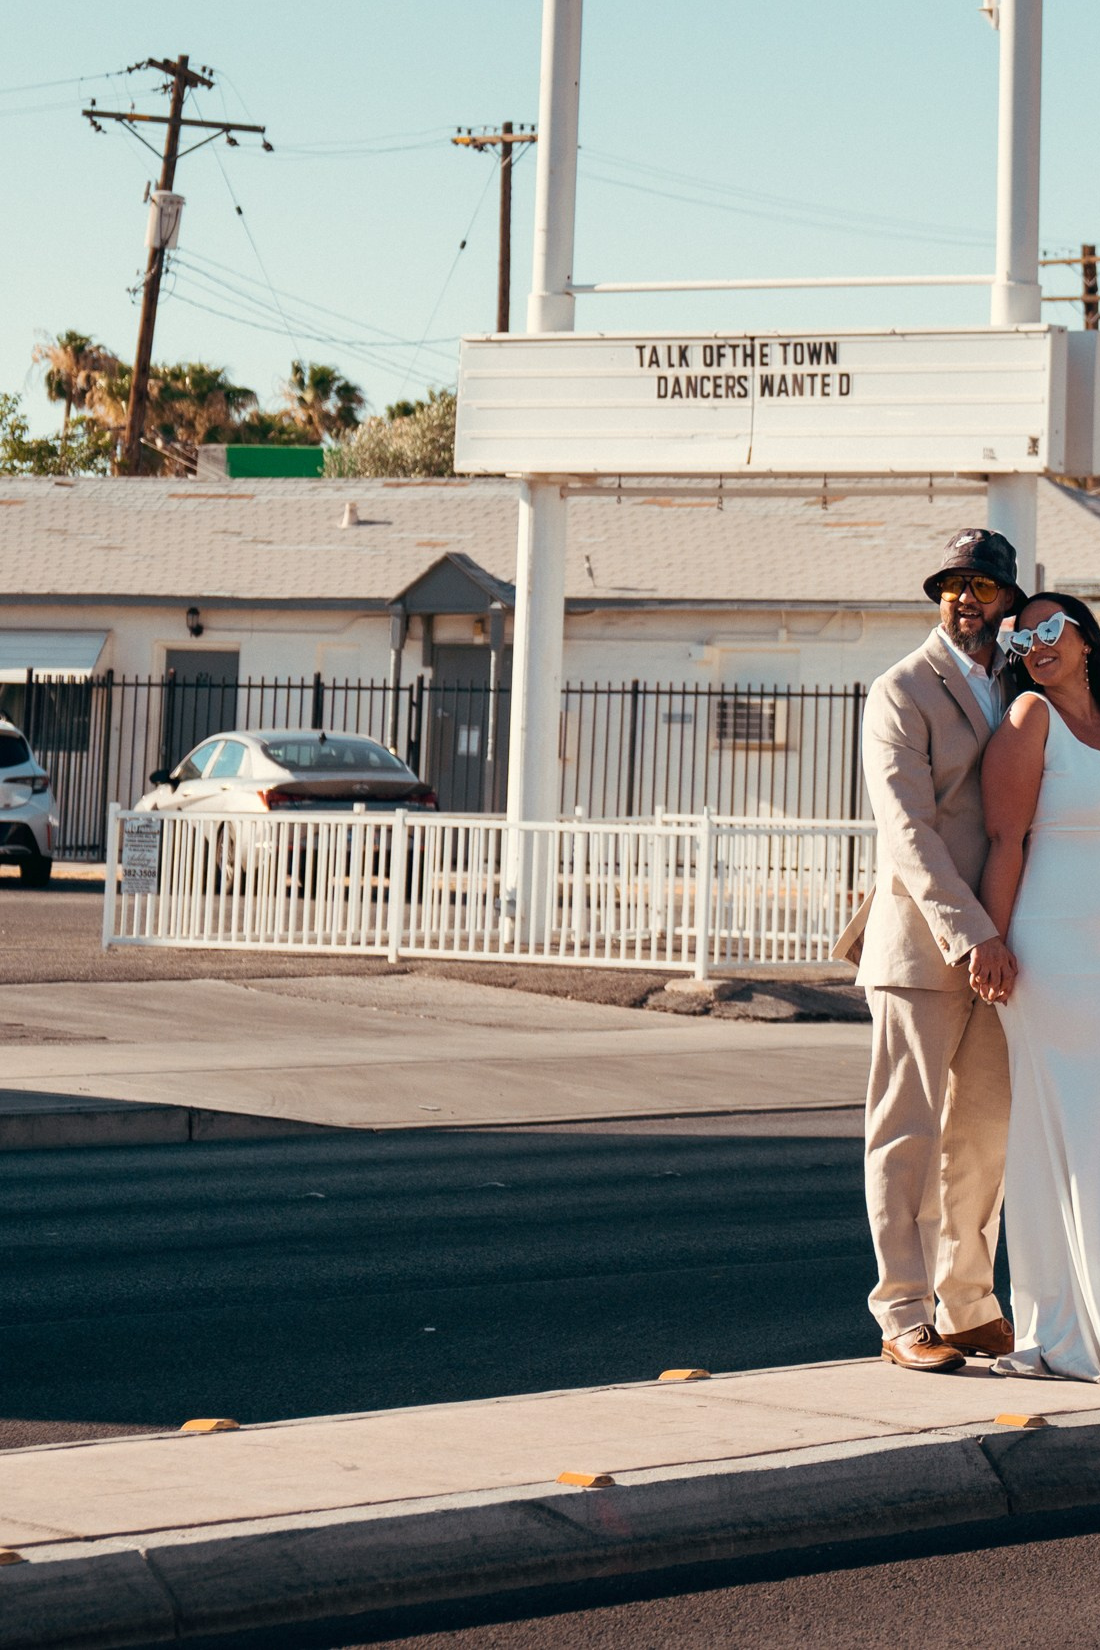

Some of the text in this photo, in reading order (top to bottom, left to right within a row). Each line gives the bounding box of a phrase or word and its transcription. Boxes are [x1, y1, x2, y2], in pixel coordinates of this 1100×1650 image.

[635, 344, 690, 368] TALK
[778, 341, 838, 366] TOWN
[656, 374, 749, 399] DANCERS
